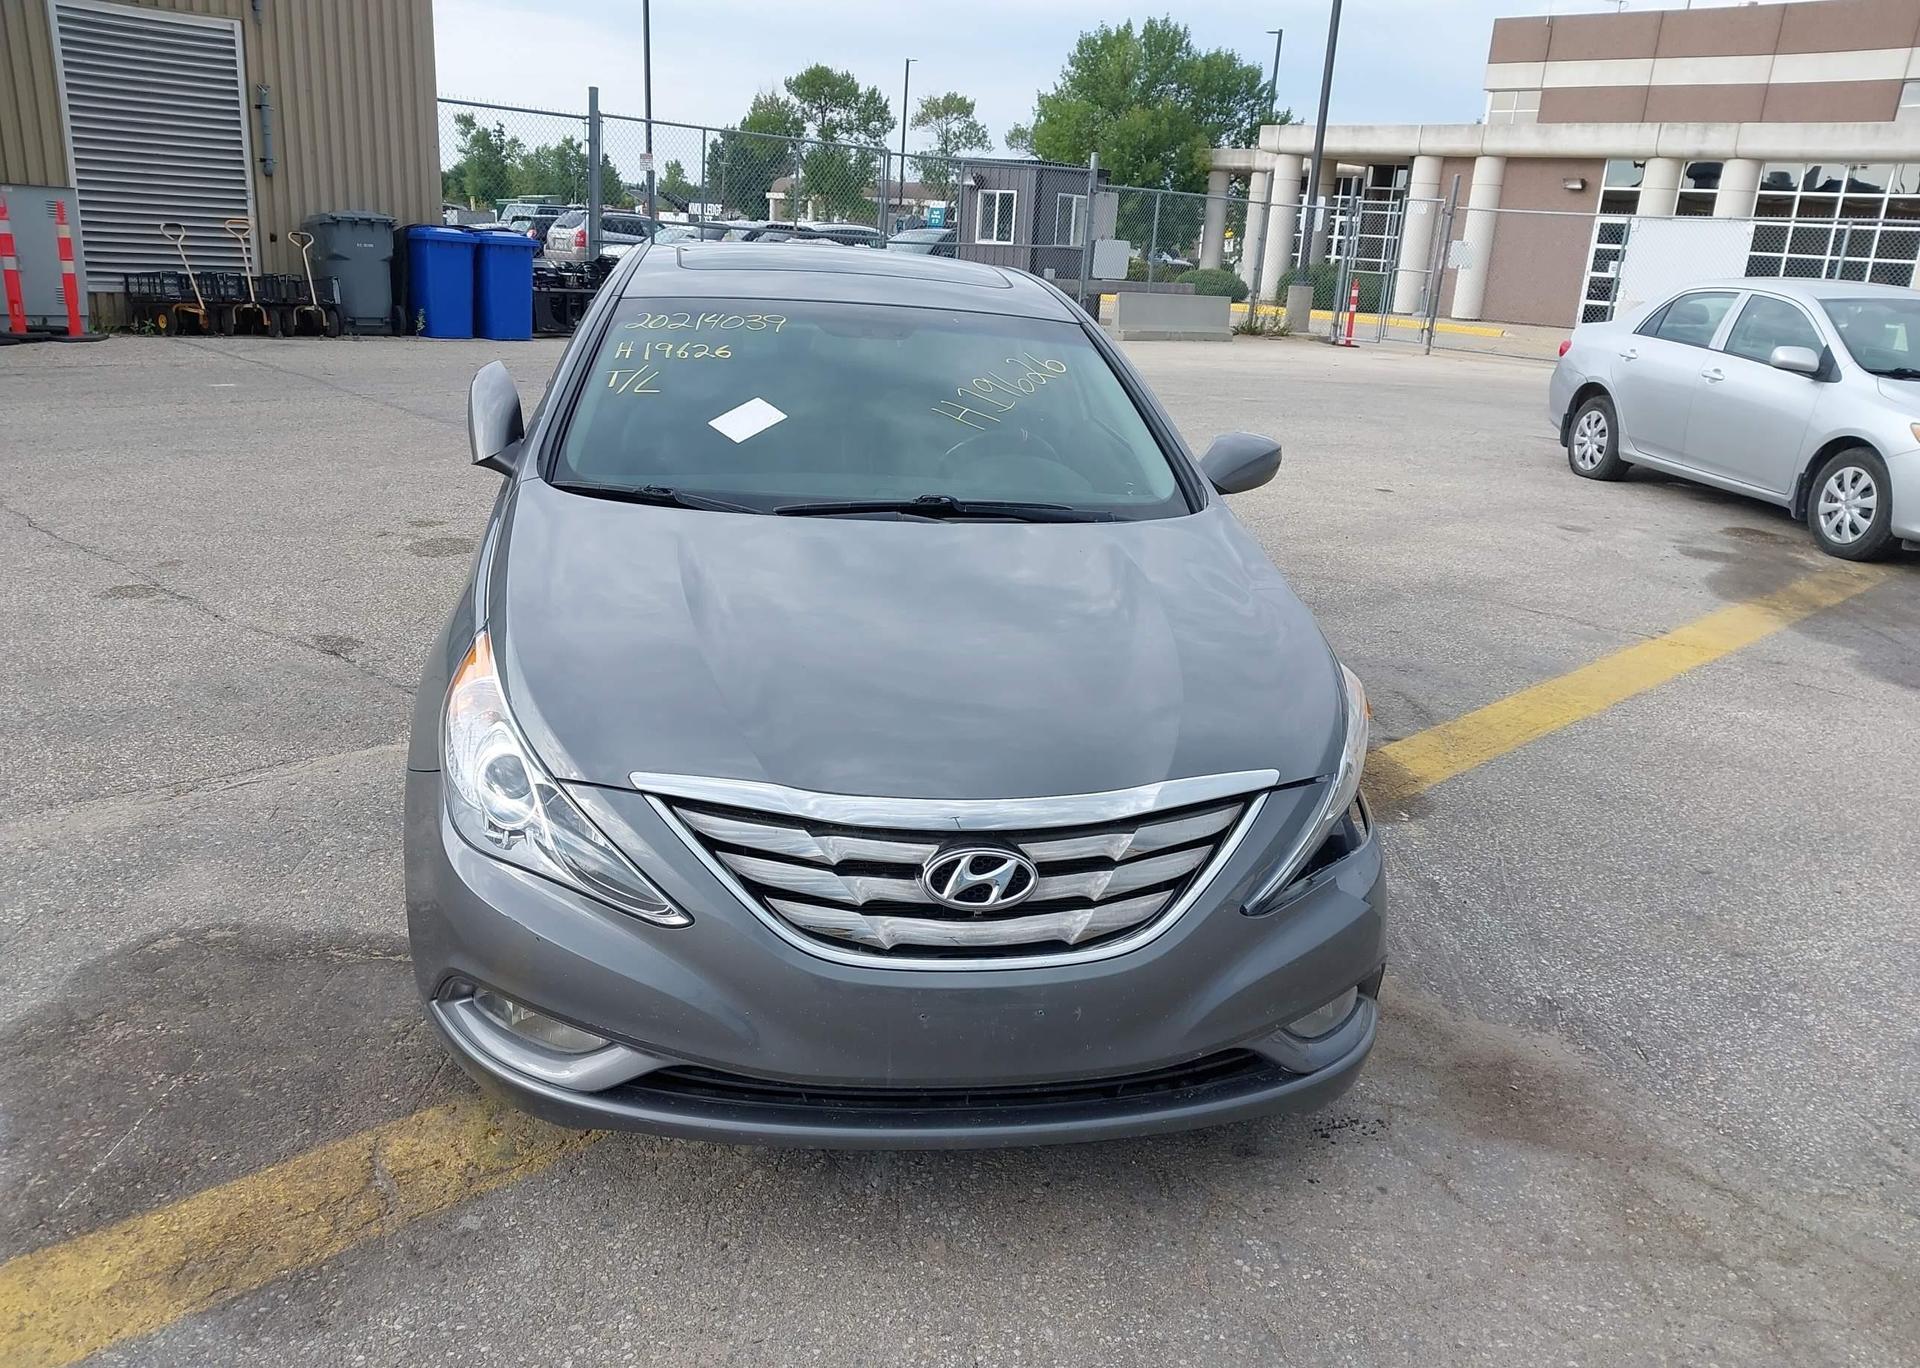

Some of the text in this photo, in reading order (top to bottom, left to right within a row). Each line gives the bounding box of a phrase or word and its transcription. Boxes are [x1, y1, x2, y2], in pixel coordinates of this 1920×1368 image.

[689, 203, 722, 216] KNOLEDGE
[625, 312, 787, 333] 20214039
[614, 340, 732, 361] H19626
[606, 364, 661, 394] T/L
